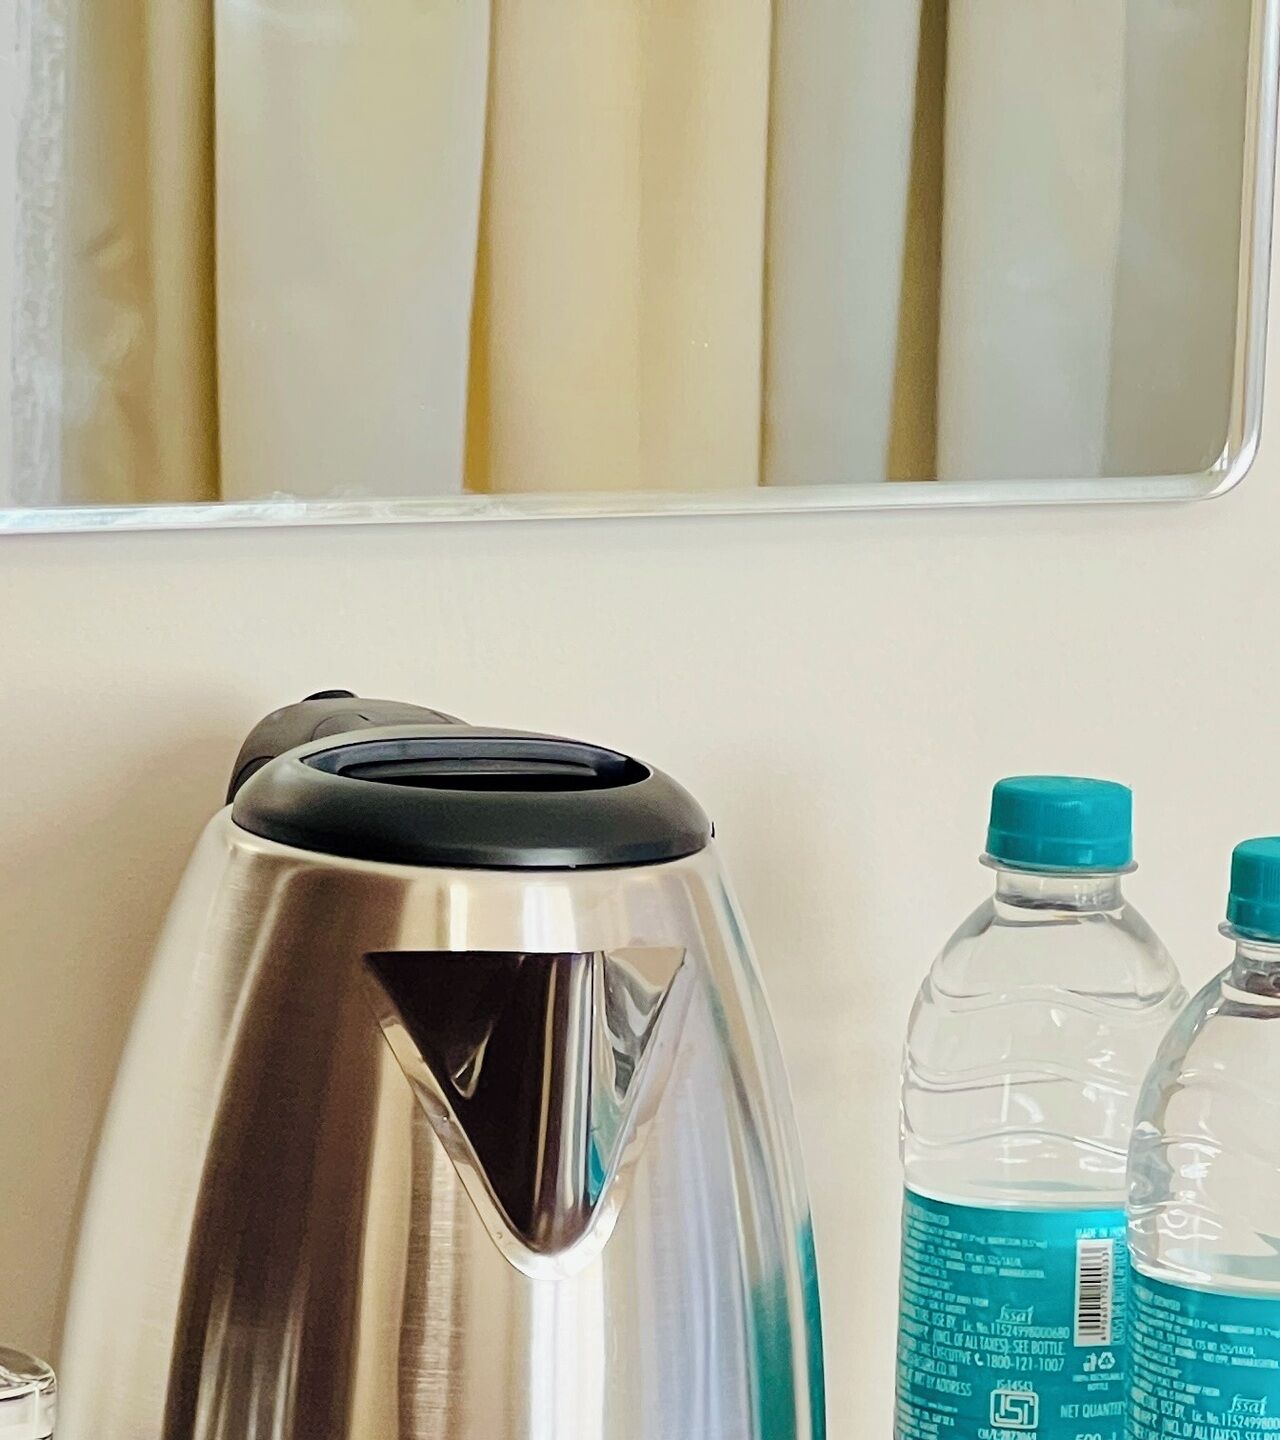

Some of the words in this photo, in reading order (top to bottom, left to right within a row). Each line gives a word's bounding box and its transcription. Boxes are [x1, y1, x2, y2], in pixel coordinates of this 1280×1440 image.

[986, 1353, 1065, 1373] 1800-121-1007
[936, 1378, 972, 1398] ADDRESS
[1060, 1404, 1080, 1418] NET
